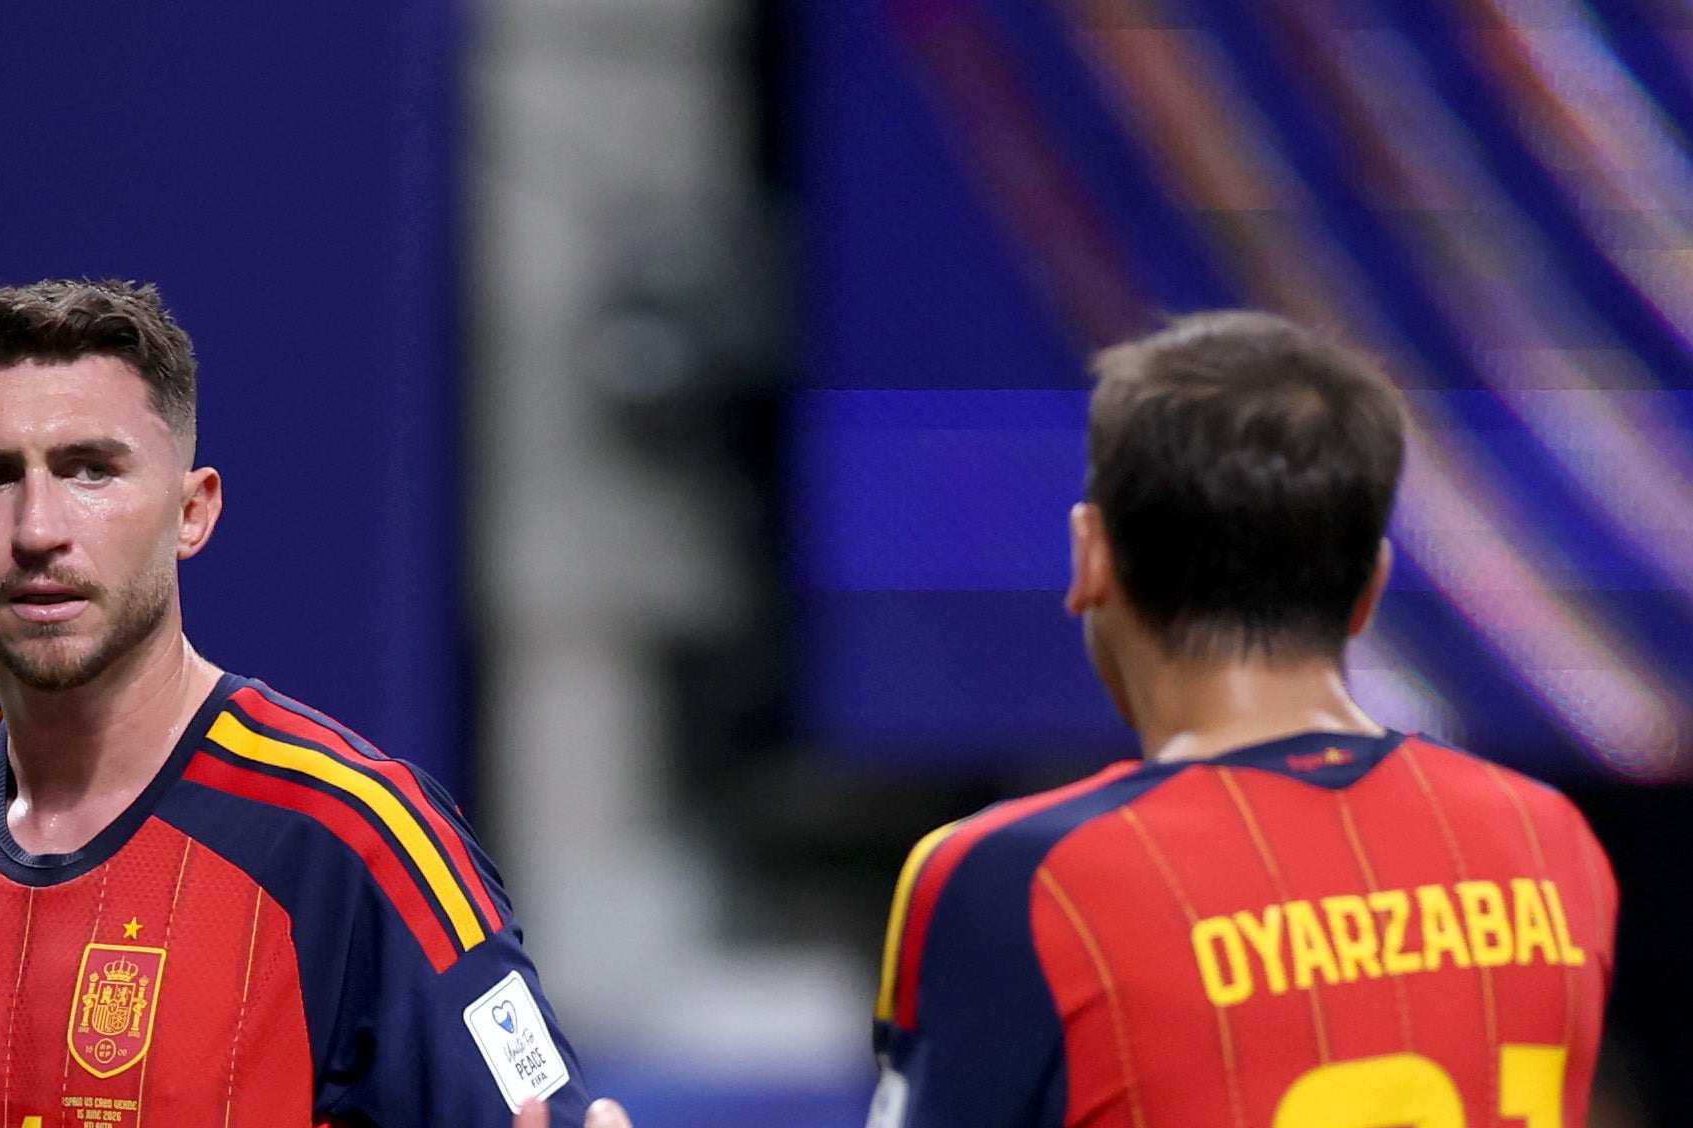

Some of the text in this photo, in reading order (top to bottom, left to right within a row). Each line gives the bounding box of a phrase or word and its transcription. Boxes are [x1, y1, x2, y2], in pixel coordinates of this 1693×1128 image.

[1191, 878, 1587, 1007] OYARZABAL
[515, 1047, 547, 1080] PEACE
[530, 1071, 548, 1088] FIFA
[103, 1110, 122, 1122] 2026
